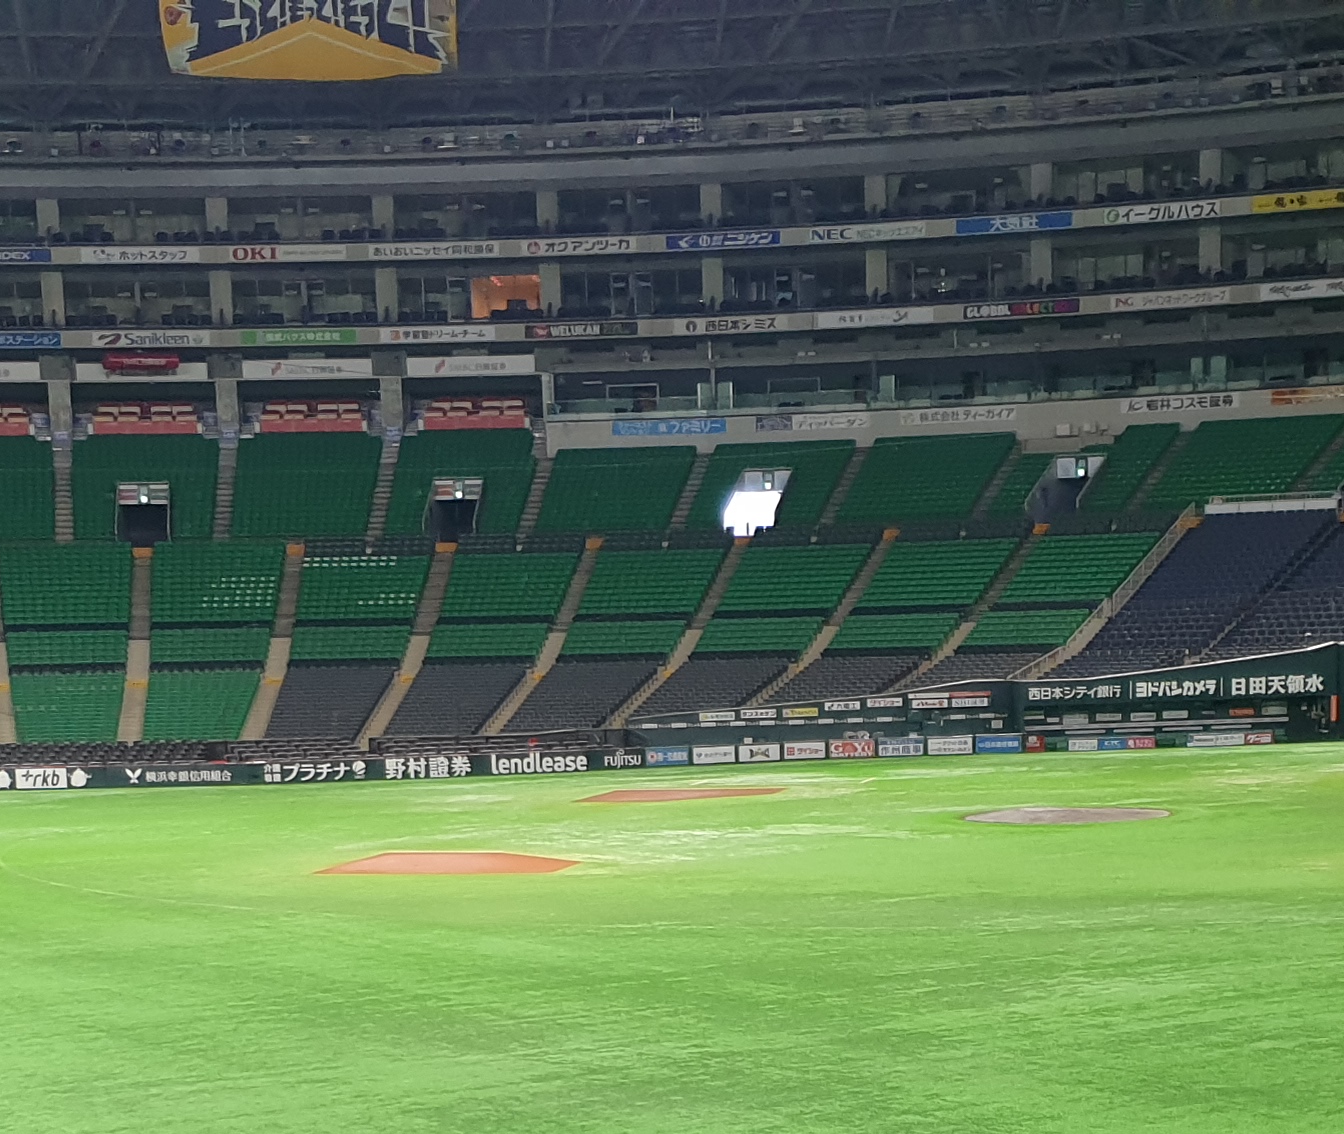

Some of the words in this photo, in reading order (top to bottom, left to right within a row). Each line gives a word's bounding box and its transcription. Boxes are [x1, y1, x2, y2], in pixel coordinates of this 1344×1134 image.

[1121, 202, 1219, 219] イーグルハウス
[811, 228, 853, 241] NEC
[233, 248, 278, 261] OKI
[373, 244, 495, 257] あいおいニッセイ同和損保
[705, 318, 778, 332] 西日本シミズ
[124, 332, 190, 346] Sanikleen
[1028, 685, 1122, 700] 西日本シティ銀行
[1136, 679, 1217, 697] ヨドバシカメラ
[1231, 674, 1325, 696] 日田天領水
[384, 756, 472, 780] 野村證券
[491, 752, 589, 775] lendlease
[604, 749, 643, 770] FUJITSU
[282, 763, 351, 782] プラチナ
